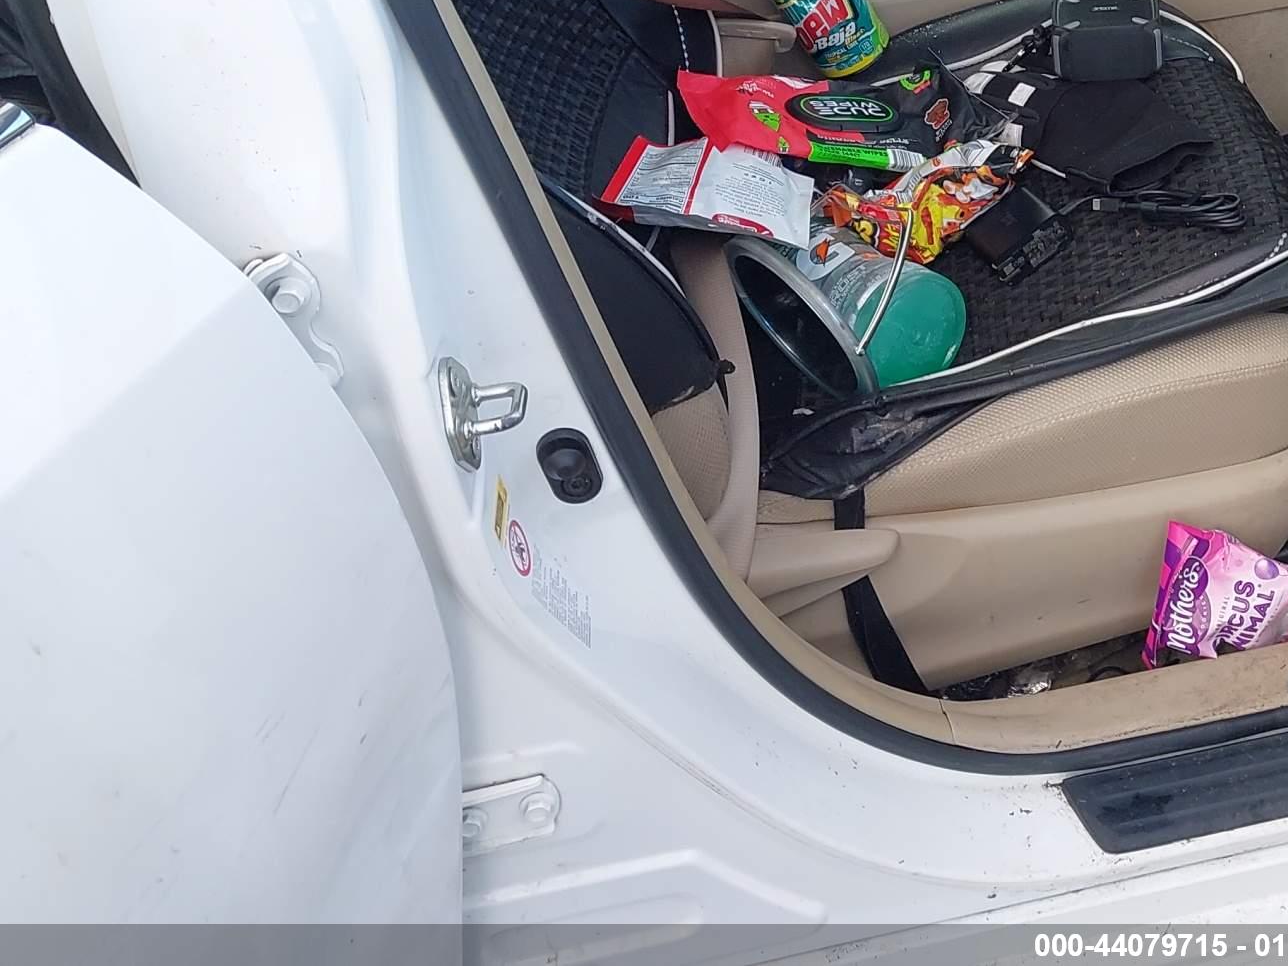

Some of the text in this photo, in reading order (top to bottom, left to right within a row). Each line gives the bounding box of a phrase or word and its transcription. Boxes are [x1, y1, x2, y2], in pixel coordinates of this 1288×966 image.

[809, 99, 880, 110] WIPES
[814, 106, 886, 117] DUDE
[1167, 562, 1199, 654] Mother's
[1231, 589, 1275, 651] NIMAL
